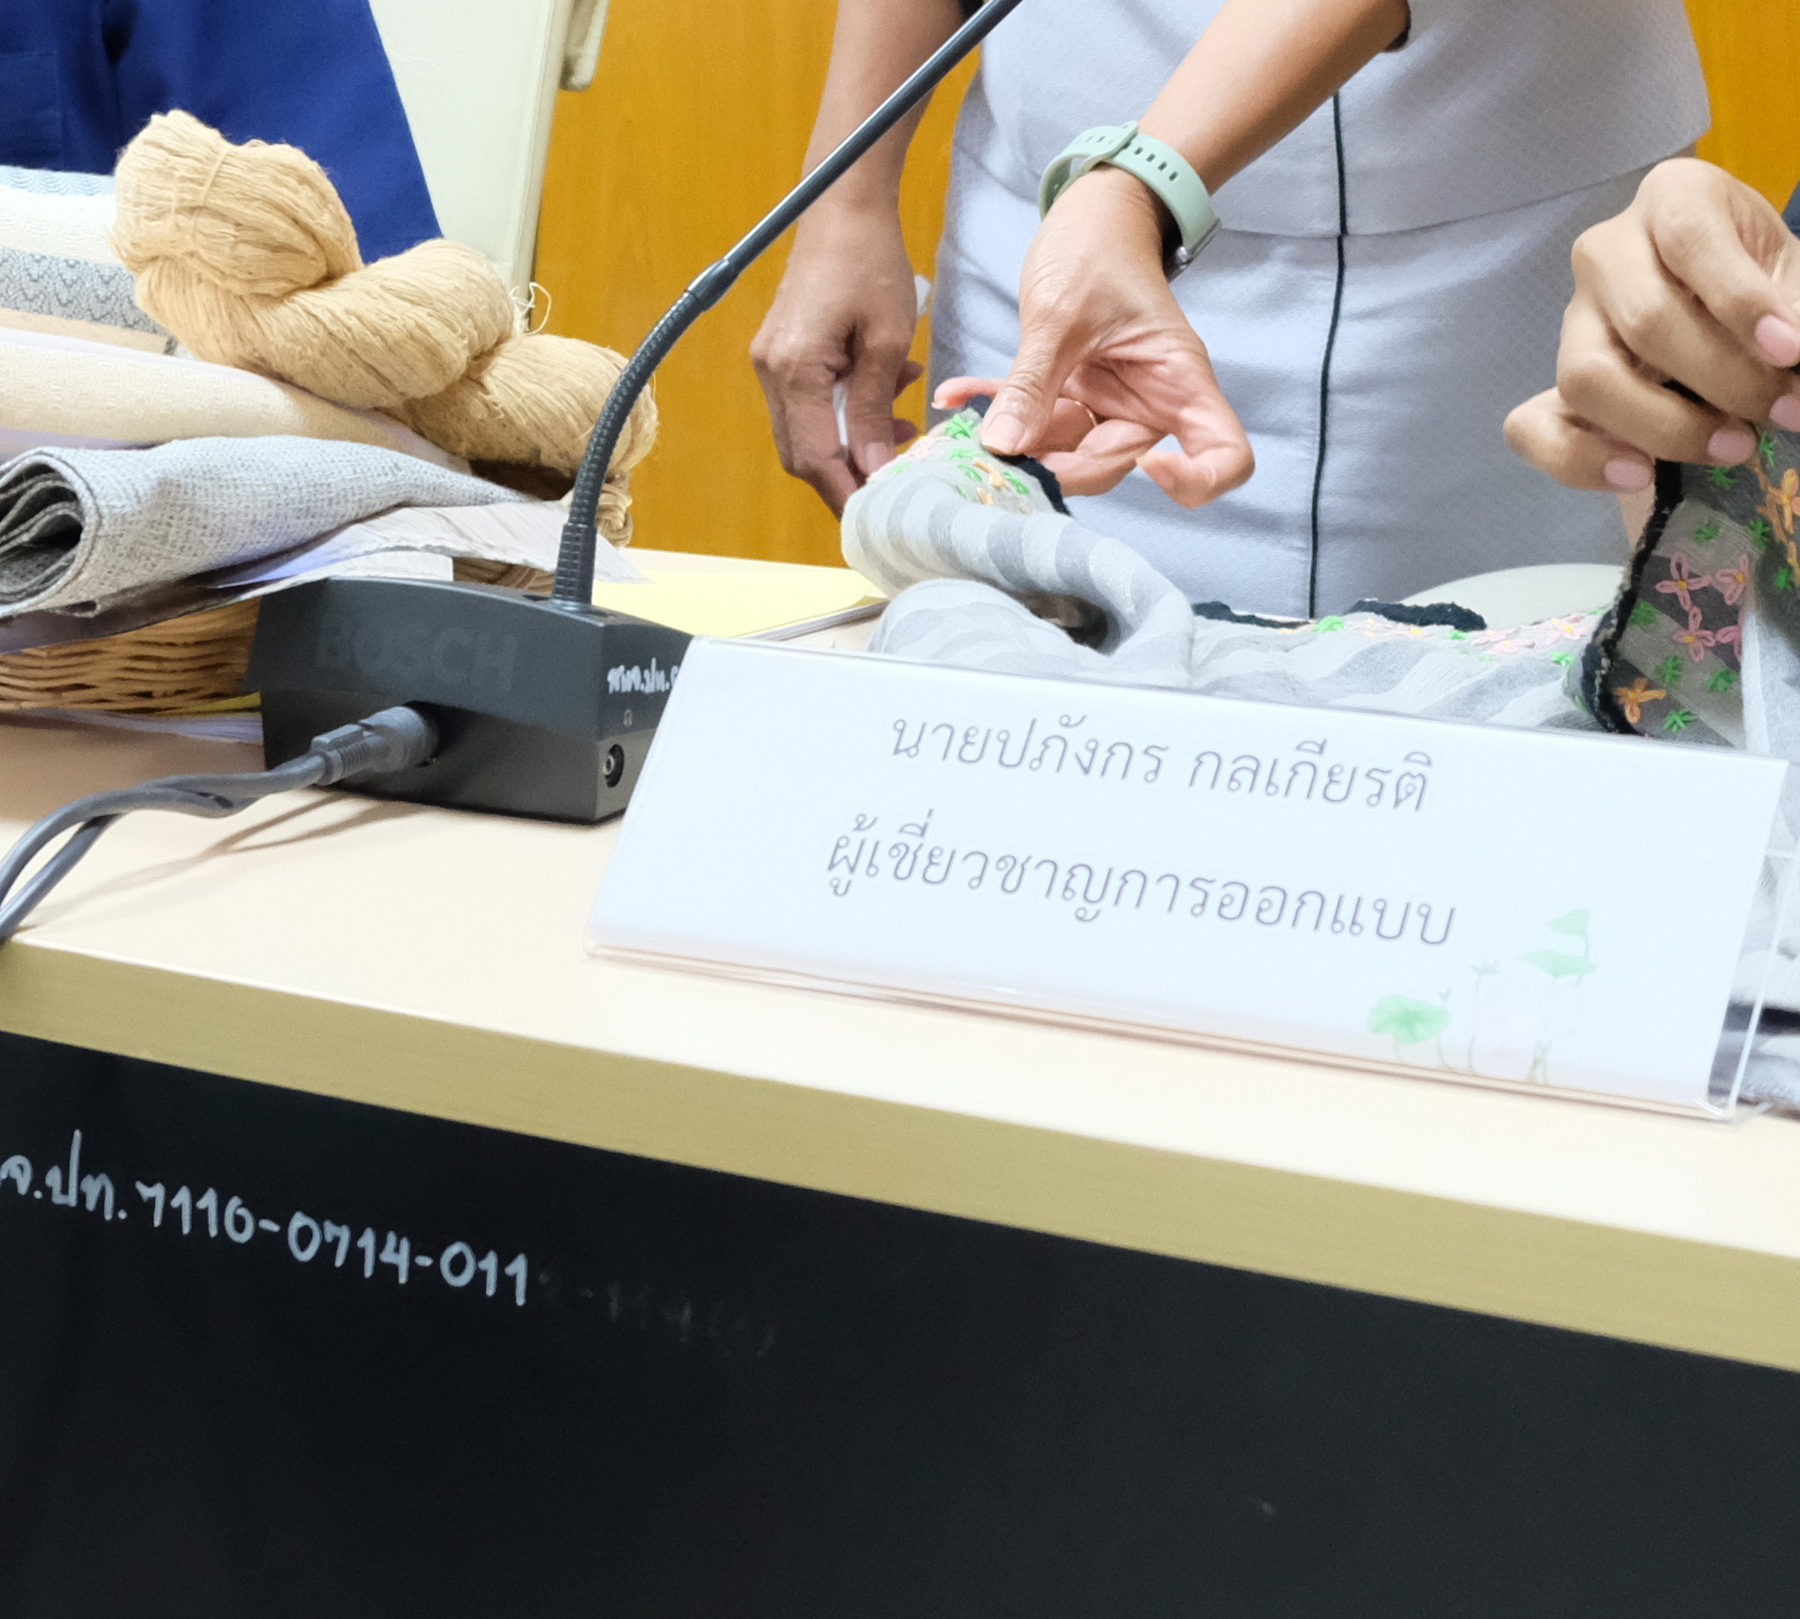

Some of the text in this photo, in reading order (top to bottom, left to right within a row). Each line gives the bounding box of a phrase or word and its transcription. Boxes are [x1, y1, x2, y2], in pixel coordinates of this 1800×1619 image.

[891, 712, 1433, 813] นายปภังกร กลเกียรติ
[826, 807, 1457, 947] ผู้เชี่ยวชาญการออกแบบ
[135, 1180, 530, 1307] 7116-0714-011
